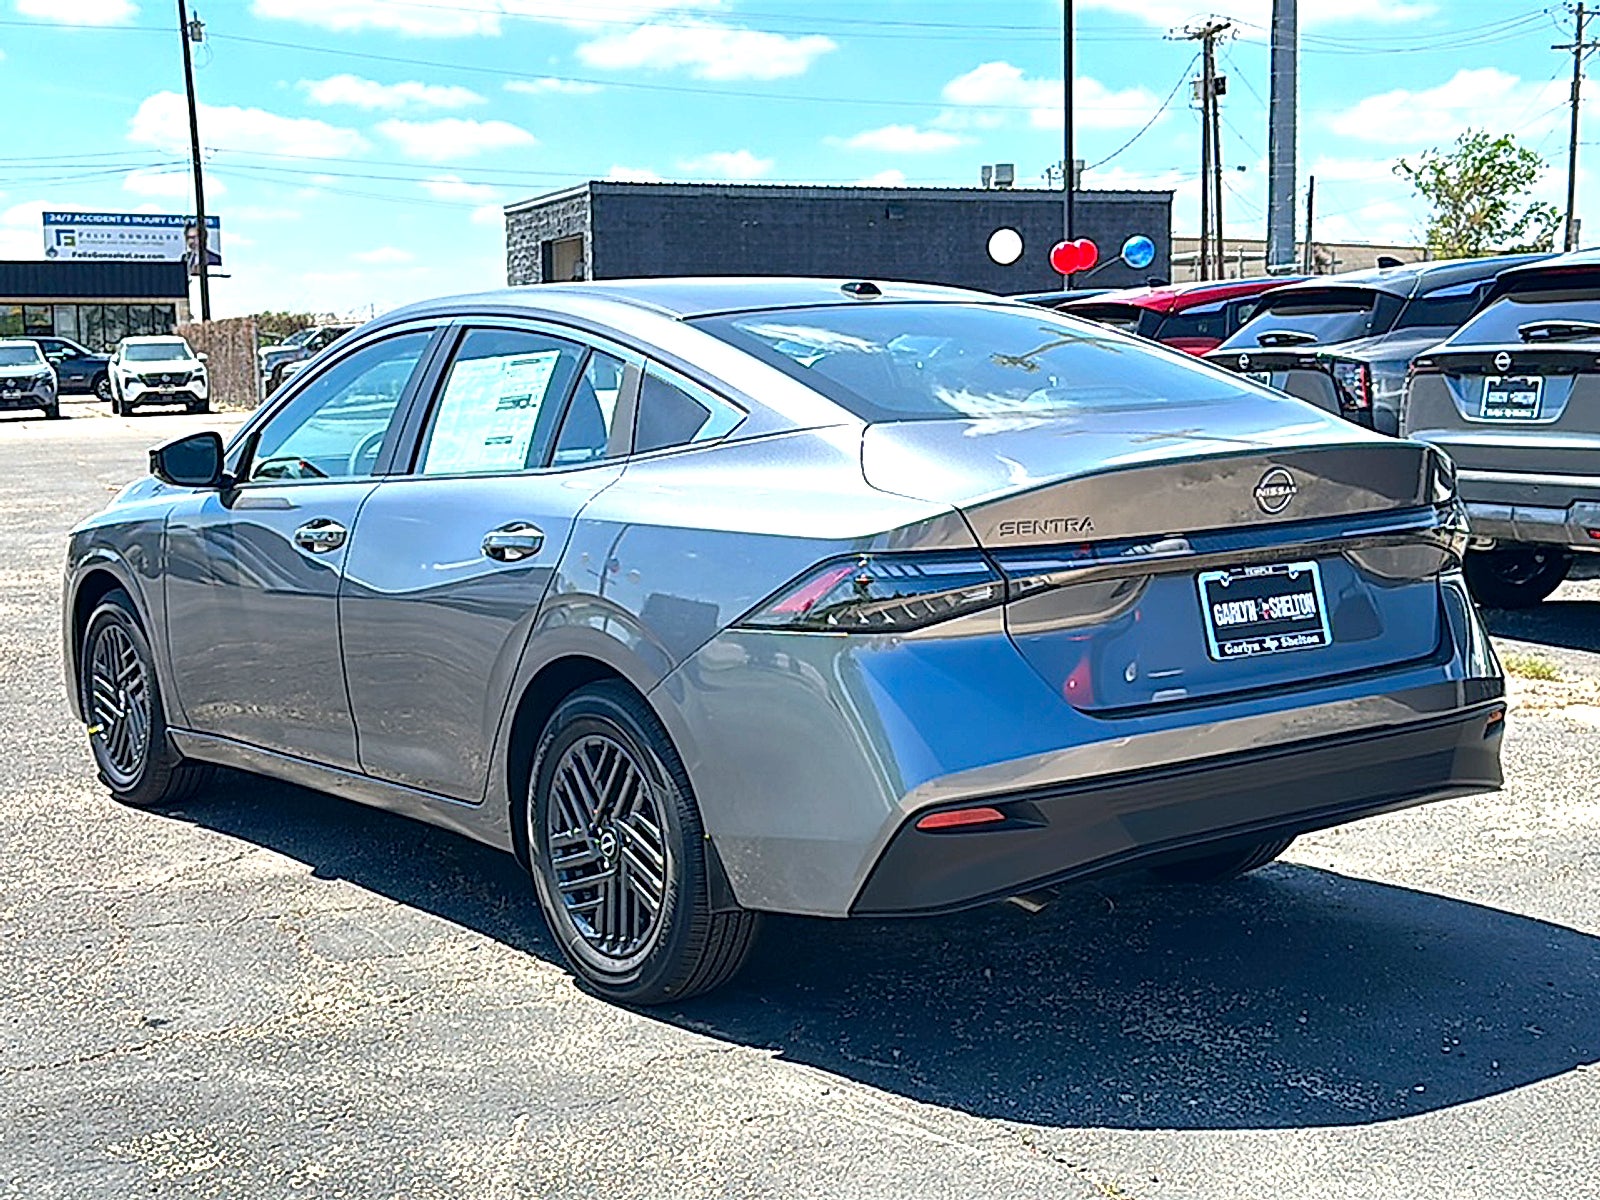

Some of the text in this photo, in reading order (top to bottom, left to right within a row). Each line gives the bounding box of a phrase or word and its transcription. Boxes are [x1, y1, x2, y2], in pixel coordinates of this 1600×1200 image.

[50, 213, 73, 222] 24/7
[74, 214, 122, 223] ACCIDENT
[132, 216, 166, 224] INJURY
[1255, 486, 1297, 498] NISSAN
[999, 516, 1095, 537] SENTRA
[1213, 592, 1317, 626] GARLYN SHELTON
[1280, 634, 1320, 648] Shelton
